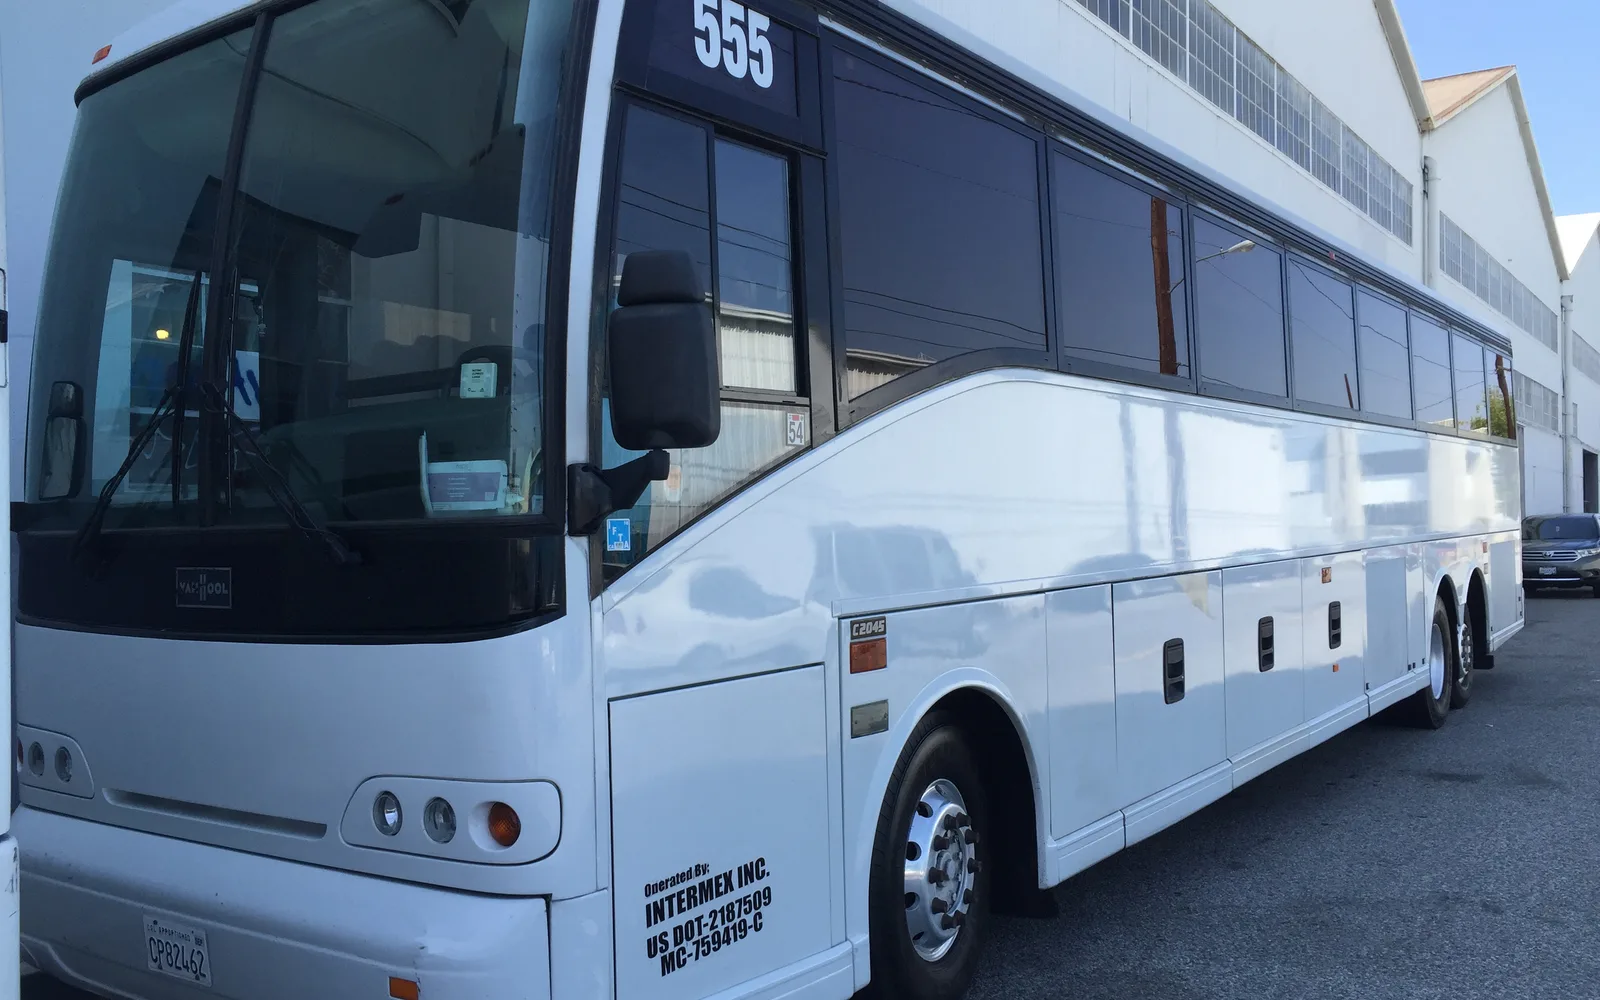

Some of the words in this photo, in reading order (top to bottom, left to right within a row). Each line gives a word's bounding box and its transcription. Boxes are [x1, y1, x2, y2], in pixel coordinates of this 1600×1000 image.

[694, 0, 773, 88] 555
[789, 421, 804, 444] 54
[852, 620, 885, 636] C2045
[644, 866, 693, 898] Operated
[694, 863, 710, 878] By:
[645, 869, 735, 929] INTERMEX
[737, 857, 771, 889] INC.
[646, 930, 670, 959] US
[672, 886, 772, 948] DOT-2187509
[660, 911, 764, 977] MC-759419-C
[149, 936, 207, 978] CP82462
